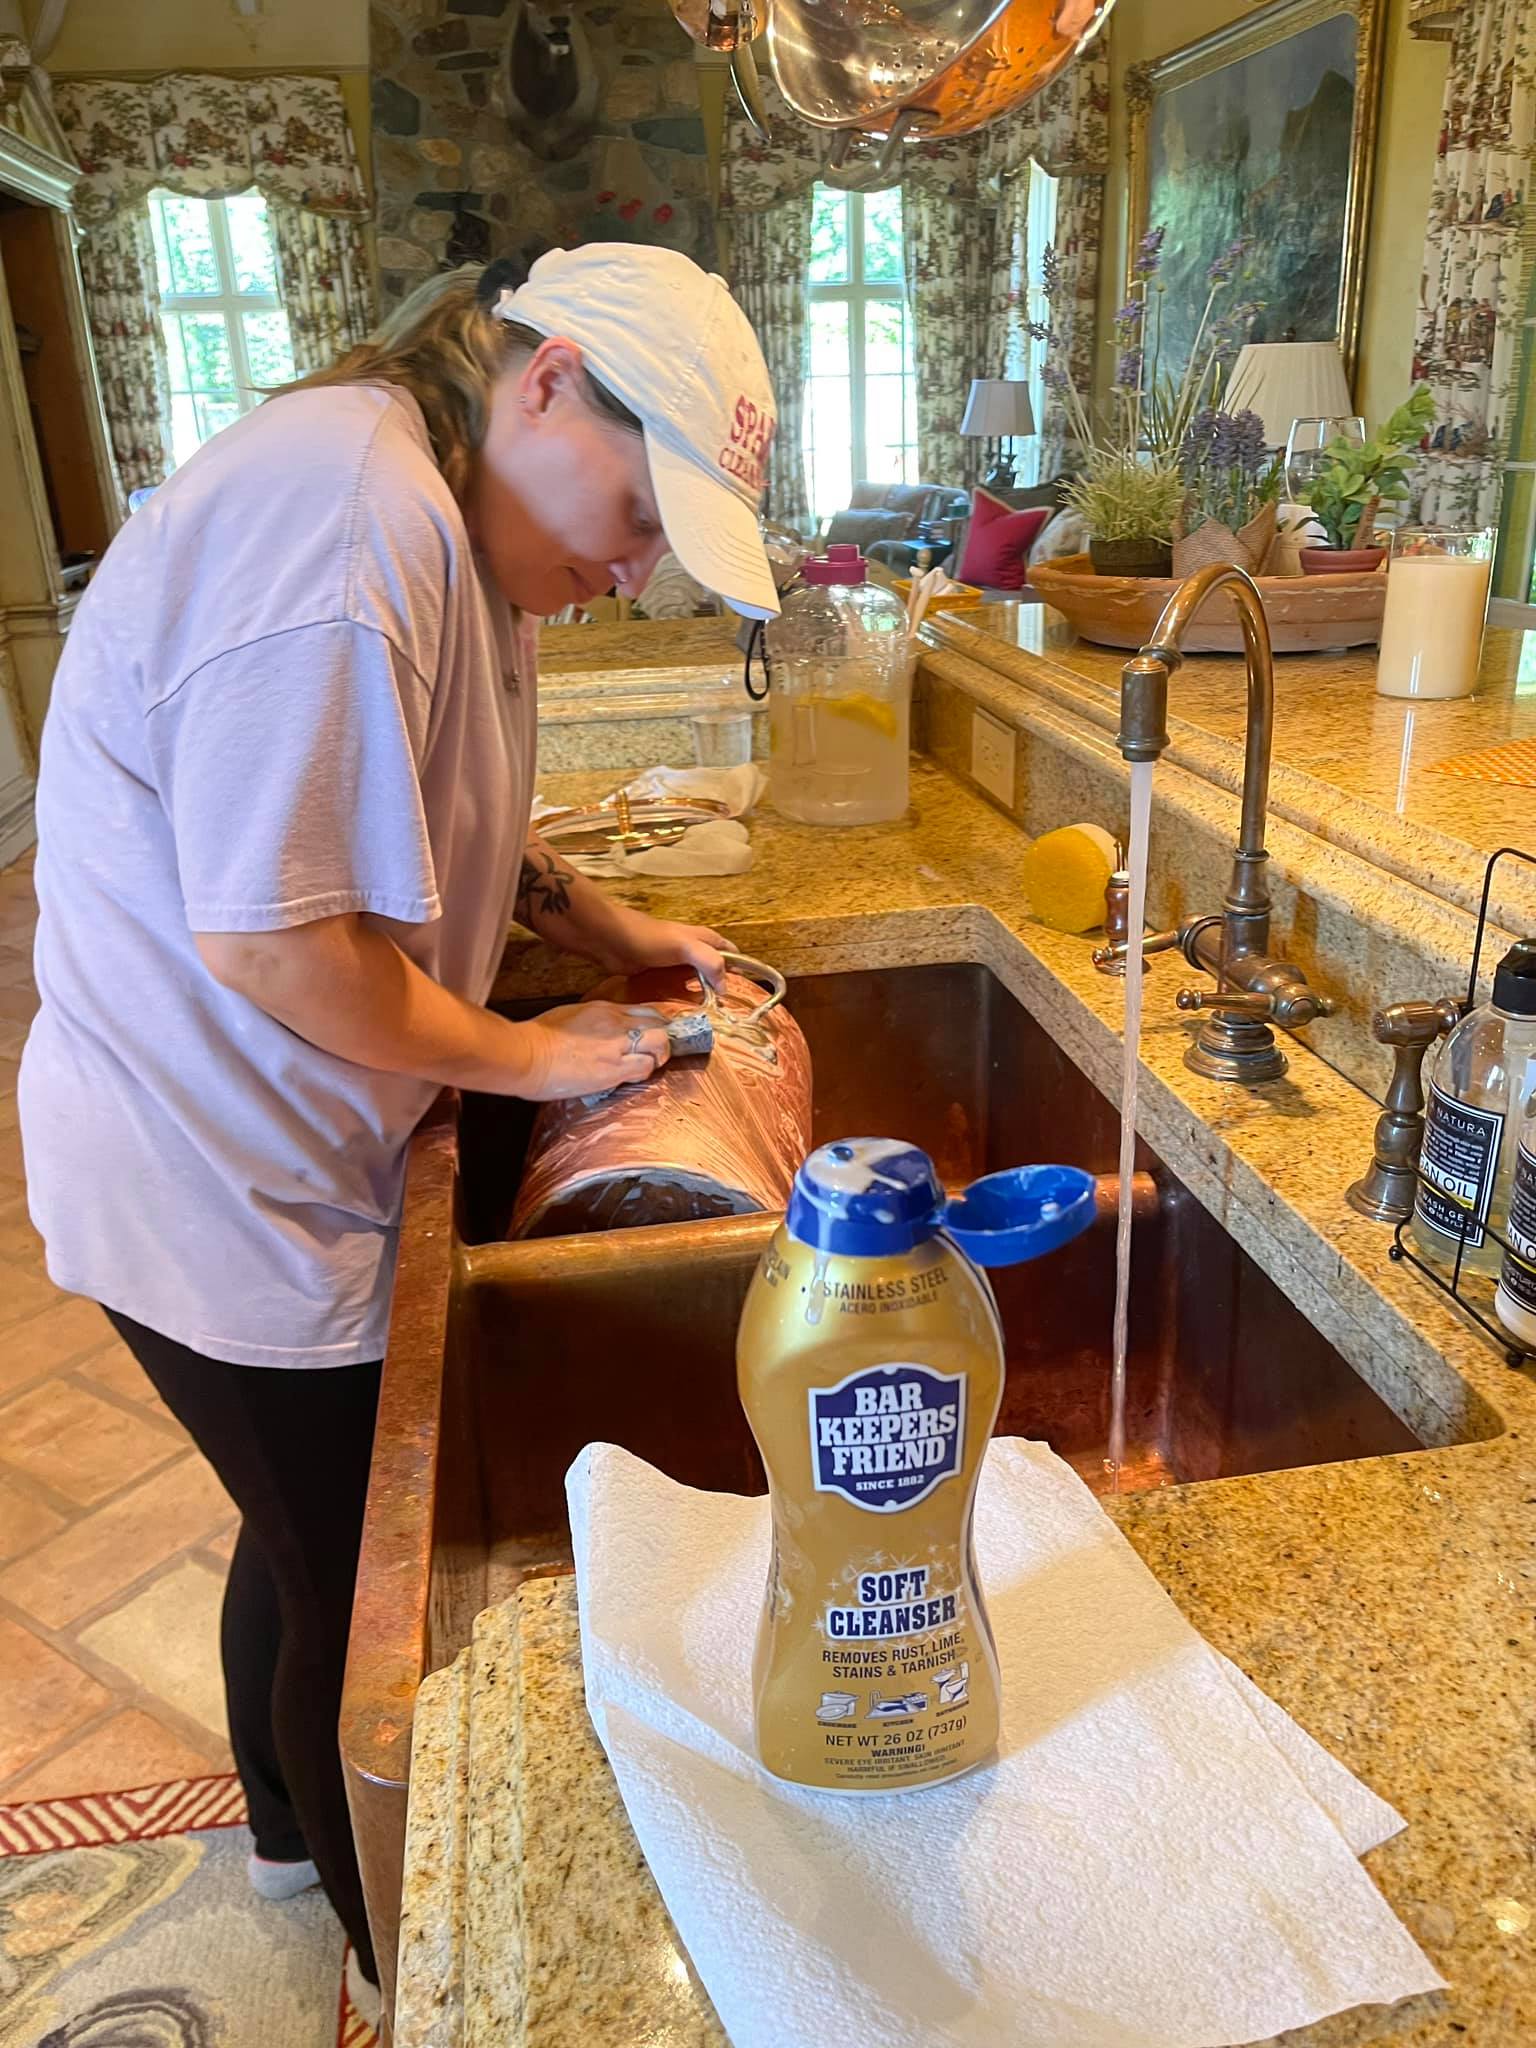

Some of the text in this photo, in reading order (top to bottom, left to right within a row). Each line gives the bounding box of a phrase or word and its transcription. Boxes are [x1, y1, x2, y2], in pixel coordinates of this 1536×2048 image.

[1436, 1108, 1486, 1137] NATURA
[1443, 1176, 1473, 1200] OIL
[1449, 1211, 1474, 1225] GE
[823, 1267, 950, 1300] STAINLESS STEEL
[855, 1382, 923, 1416] BAR
[818, 1403, 957, 1447] KEEPERS
[831, 1435, 946, 1476] FRIEND
[856, 1475, 925, 1491] SINCE 1882
[860, 1568, 927, 1604] SOFT
[829, 1594, 957, 1637] CLEANSER
[822, 1650, 887, 1664] REMOVES
[892, 1643, 929, 1661] RUST,
[832, 1649, 956, 1679] STAINS & TARNISH
[826, 1715, 967, 1747] NET WT 26 OZ (737g)
[871, 1743, 925, 1758] WARNING!
